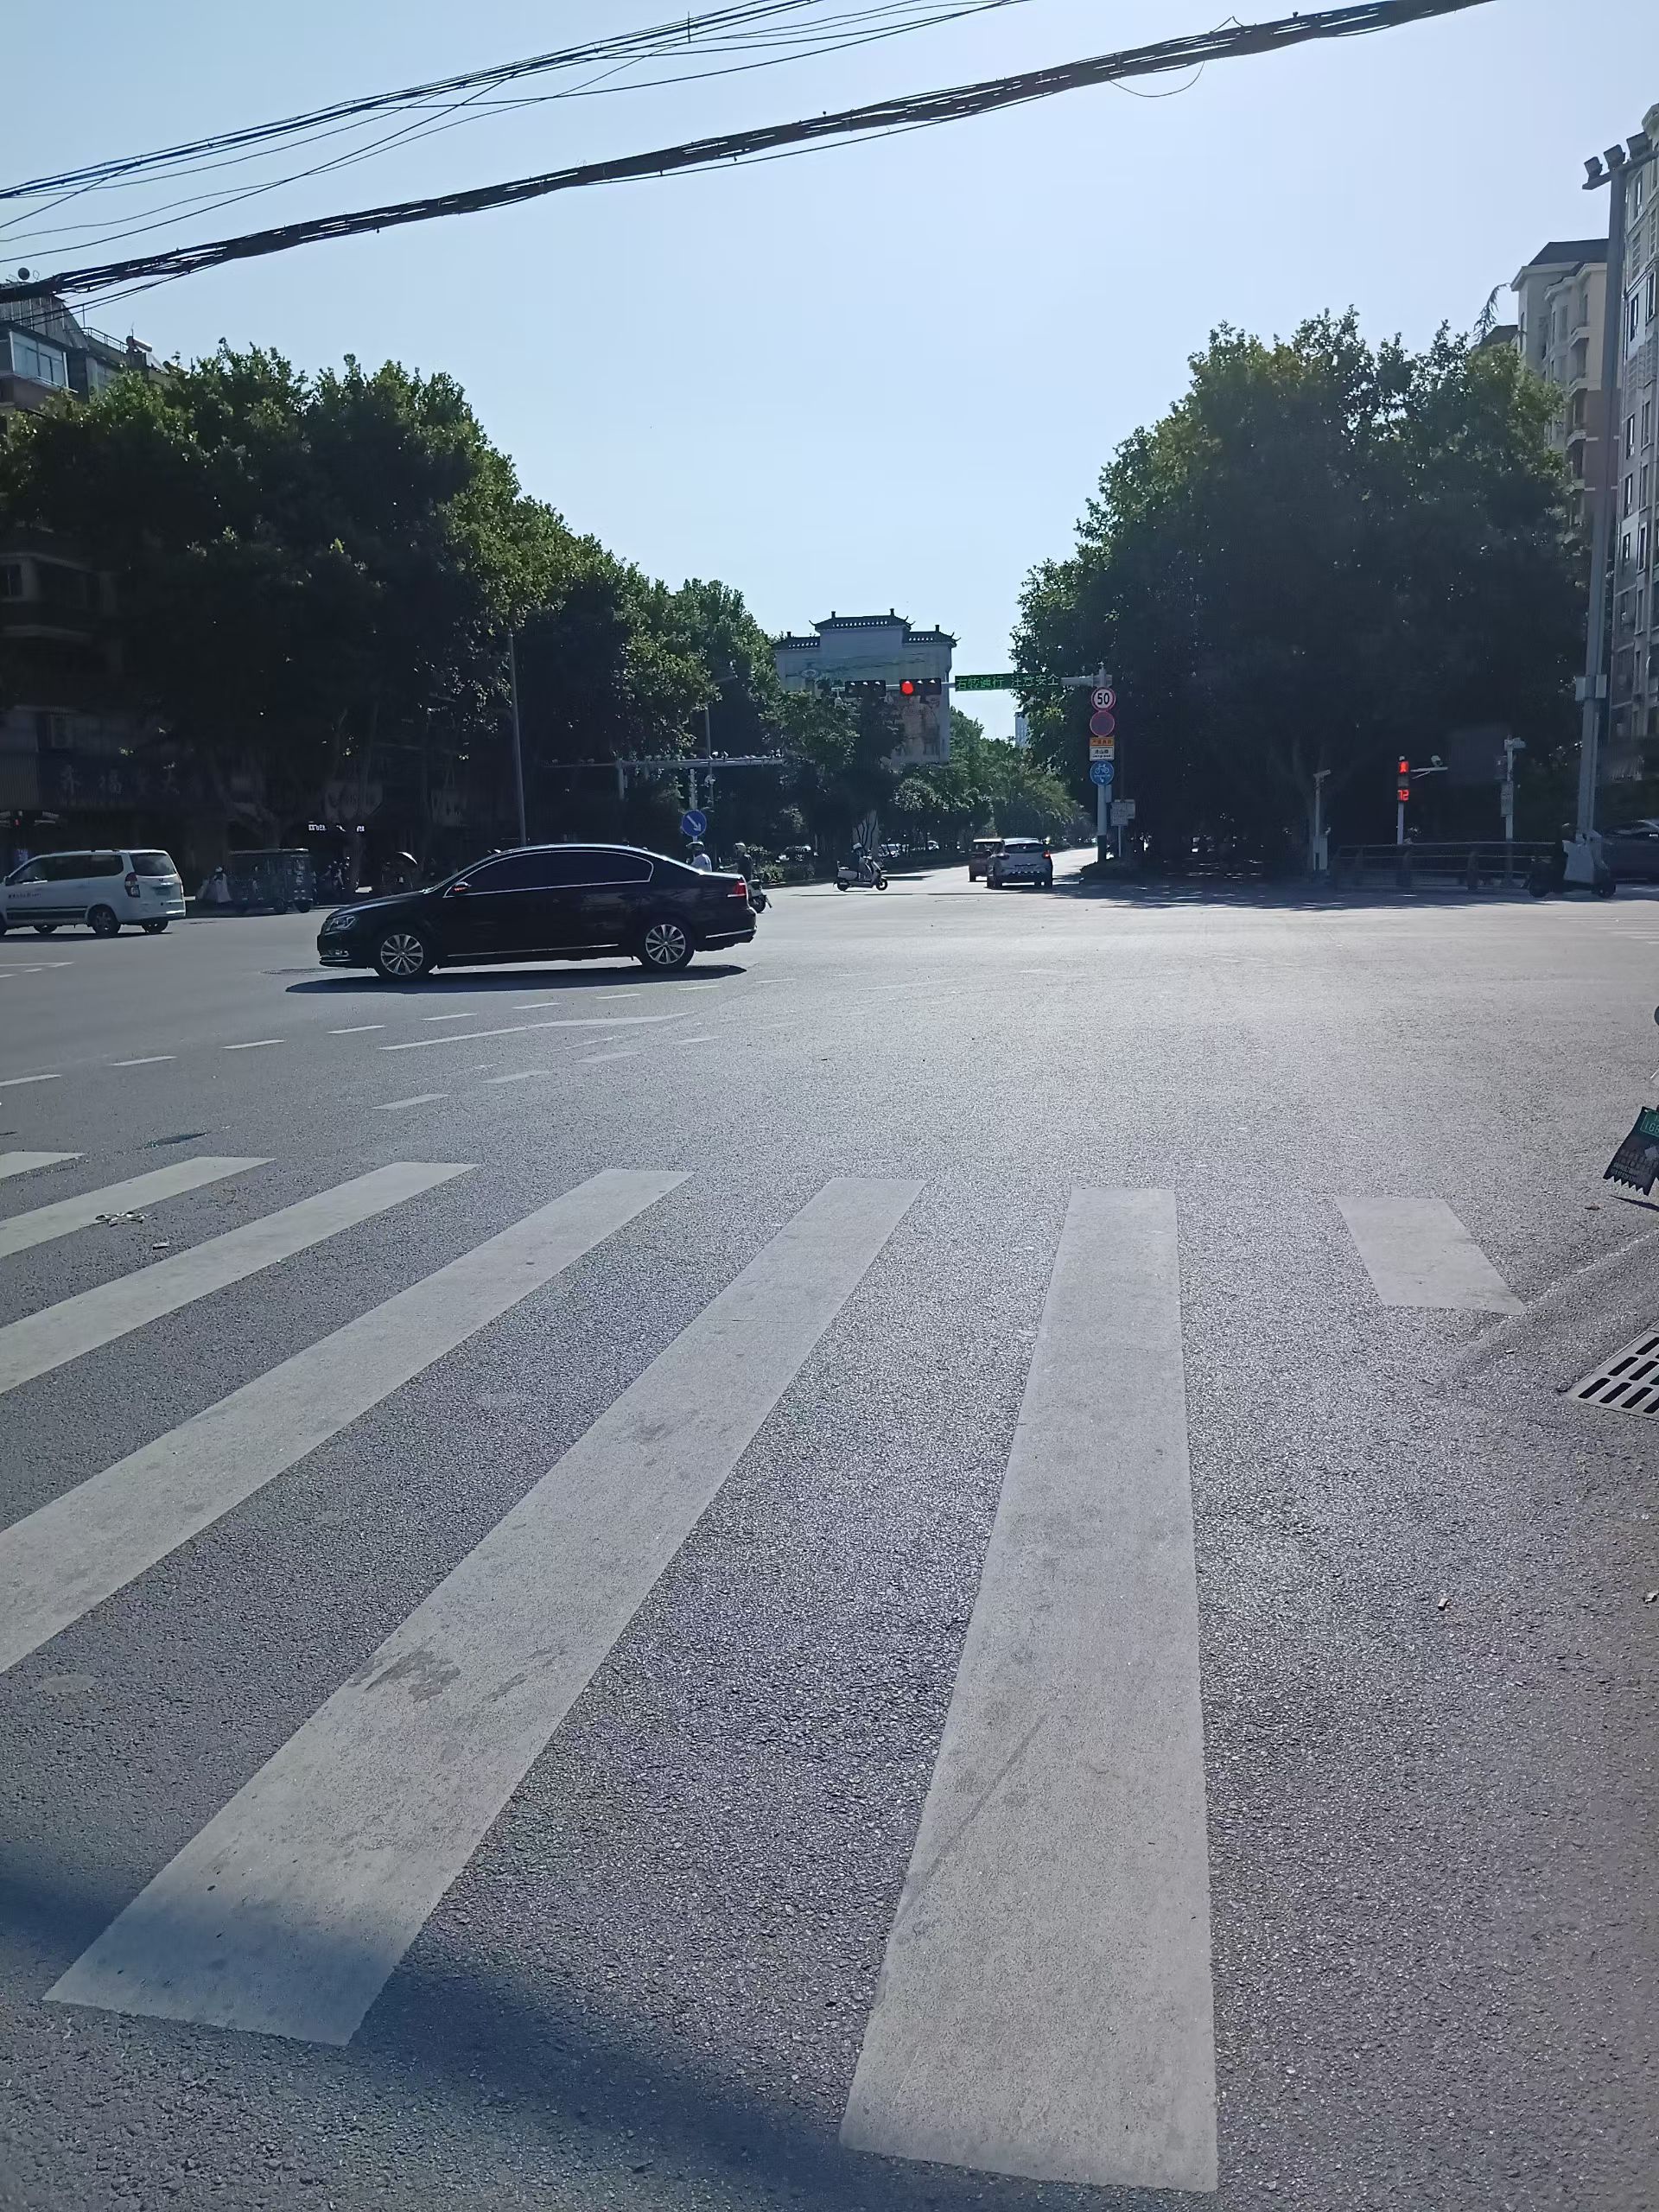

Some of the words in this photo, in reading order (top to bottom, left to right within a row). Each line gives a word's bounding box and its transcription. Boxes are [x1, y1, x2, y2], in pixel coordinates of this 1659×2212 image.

[1010, 674, 1059, 688] 注意安全
[1097, 692, 1109, 705] 50
[1397, 790, 1410, 801] 72
